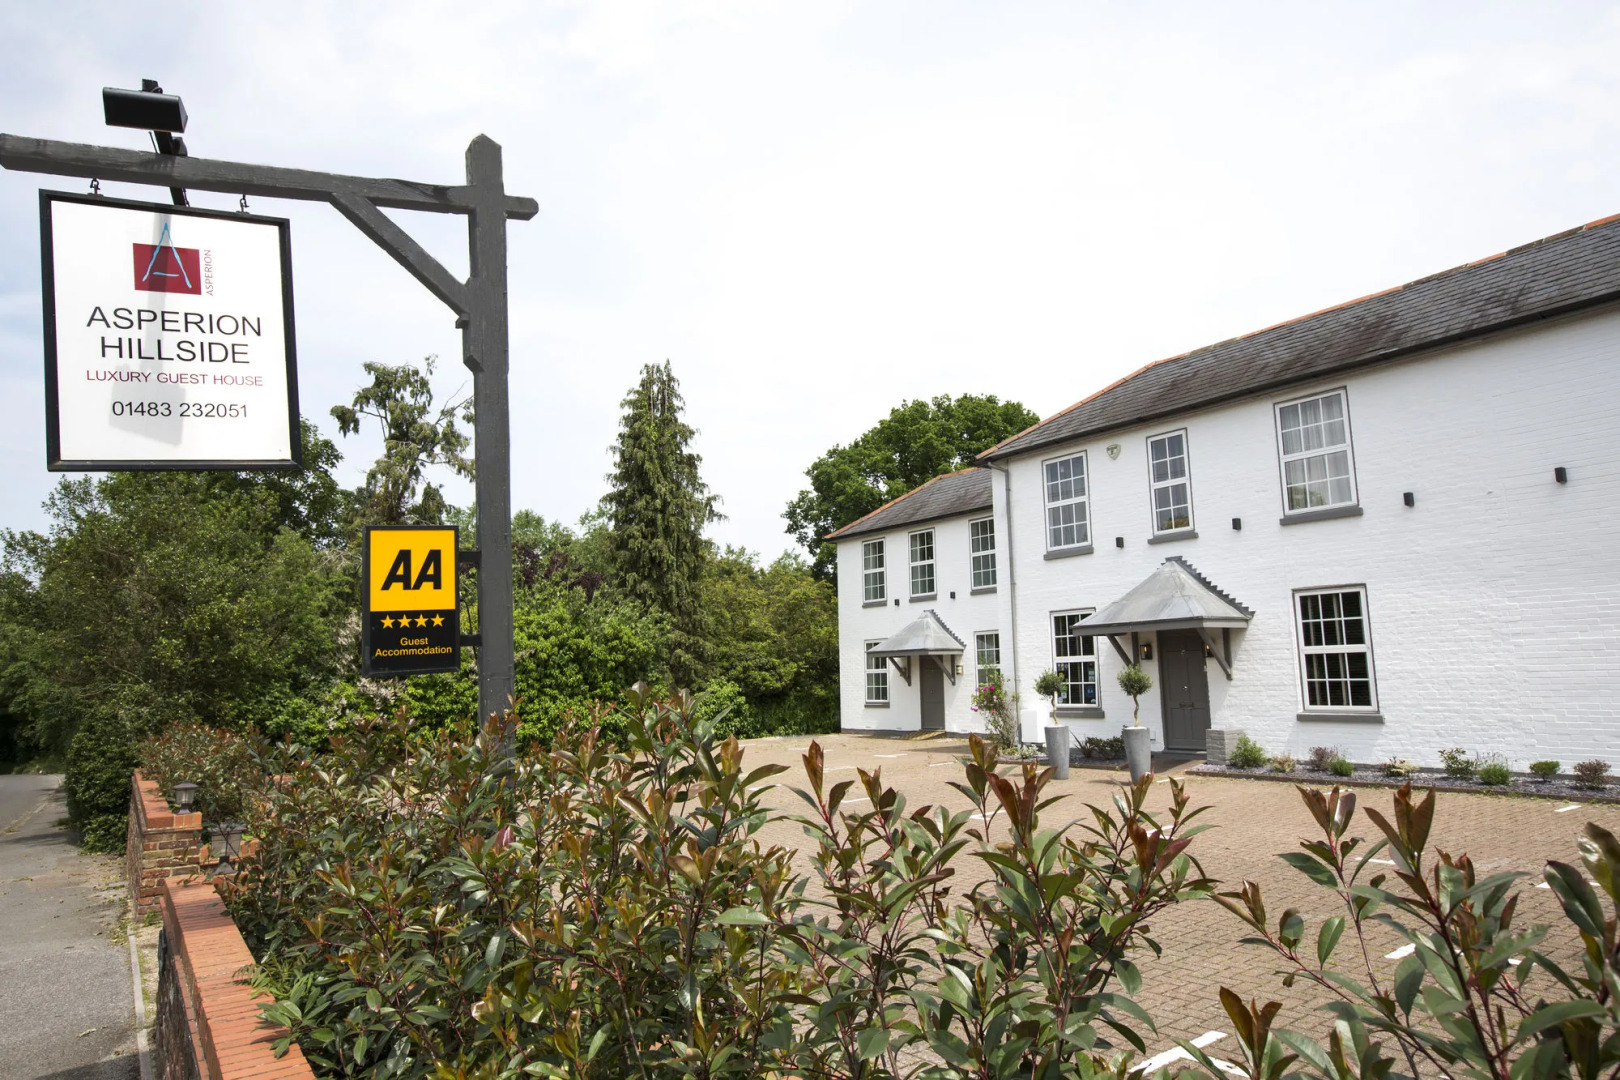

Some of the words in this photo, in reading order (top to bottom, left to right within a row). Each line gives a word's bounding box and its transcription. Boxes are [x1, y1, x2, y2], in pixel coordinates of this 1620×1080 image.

[203, 249, 213, 296] ASPERION
[86, 306, 262, 337] ASPERION
[100, 335, 250, 364] HILLSIDE
[86, 369, 152, 383] LUXURY
[156, 372, 208, 385] GUEST
[213, 374, 264, 387] HOUSE
[111, 400, 173, 418] 01483
[178, 402, 248, 418] 232051
[380, 549, 442, 591] AA
[375, 646, 453, 657] Accommodation
[400, 636, 429, 646] Guest
